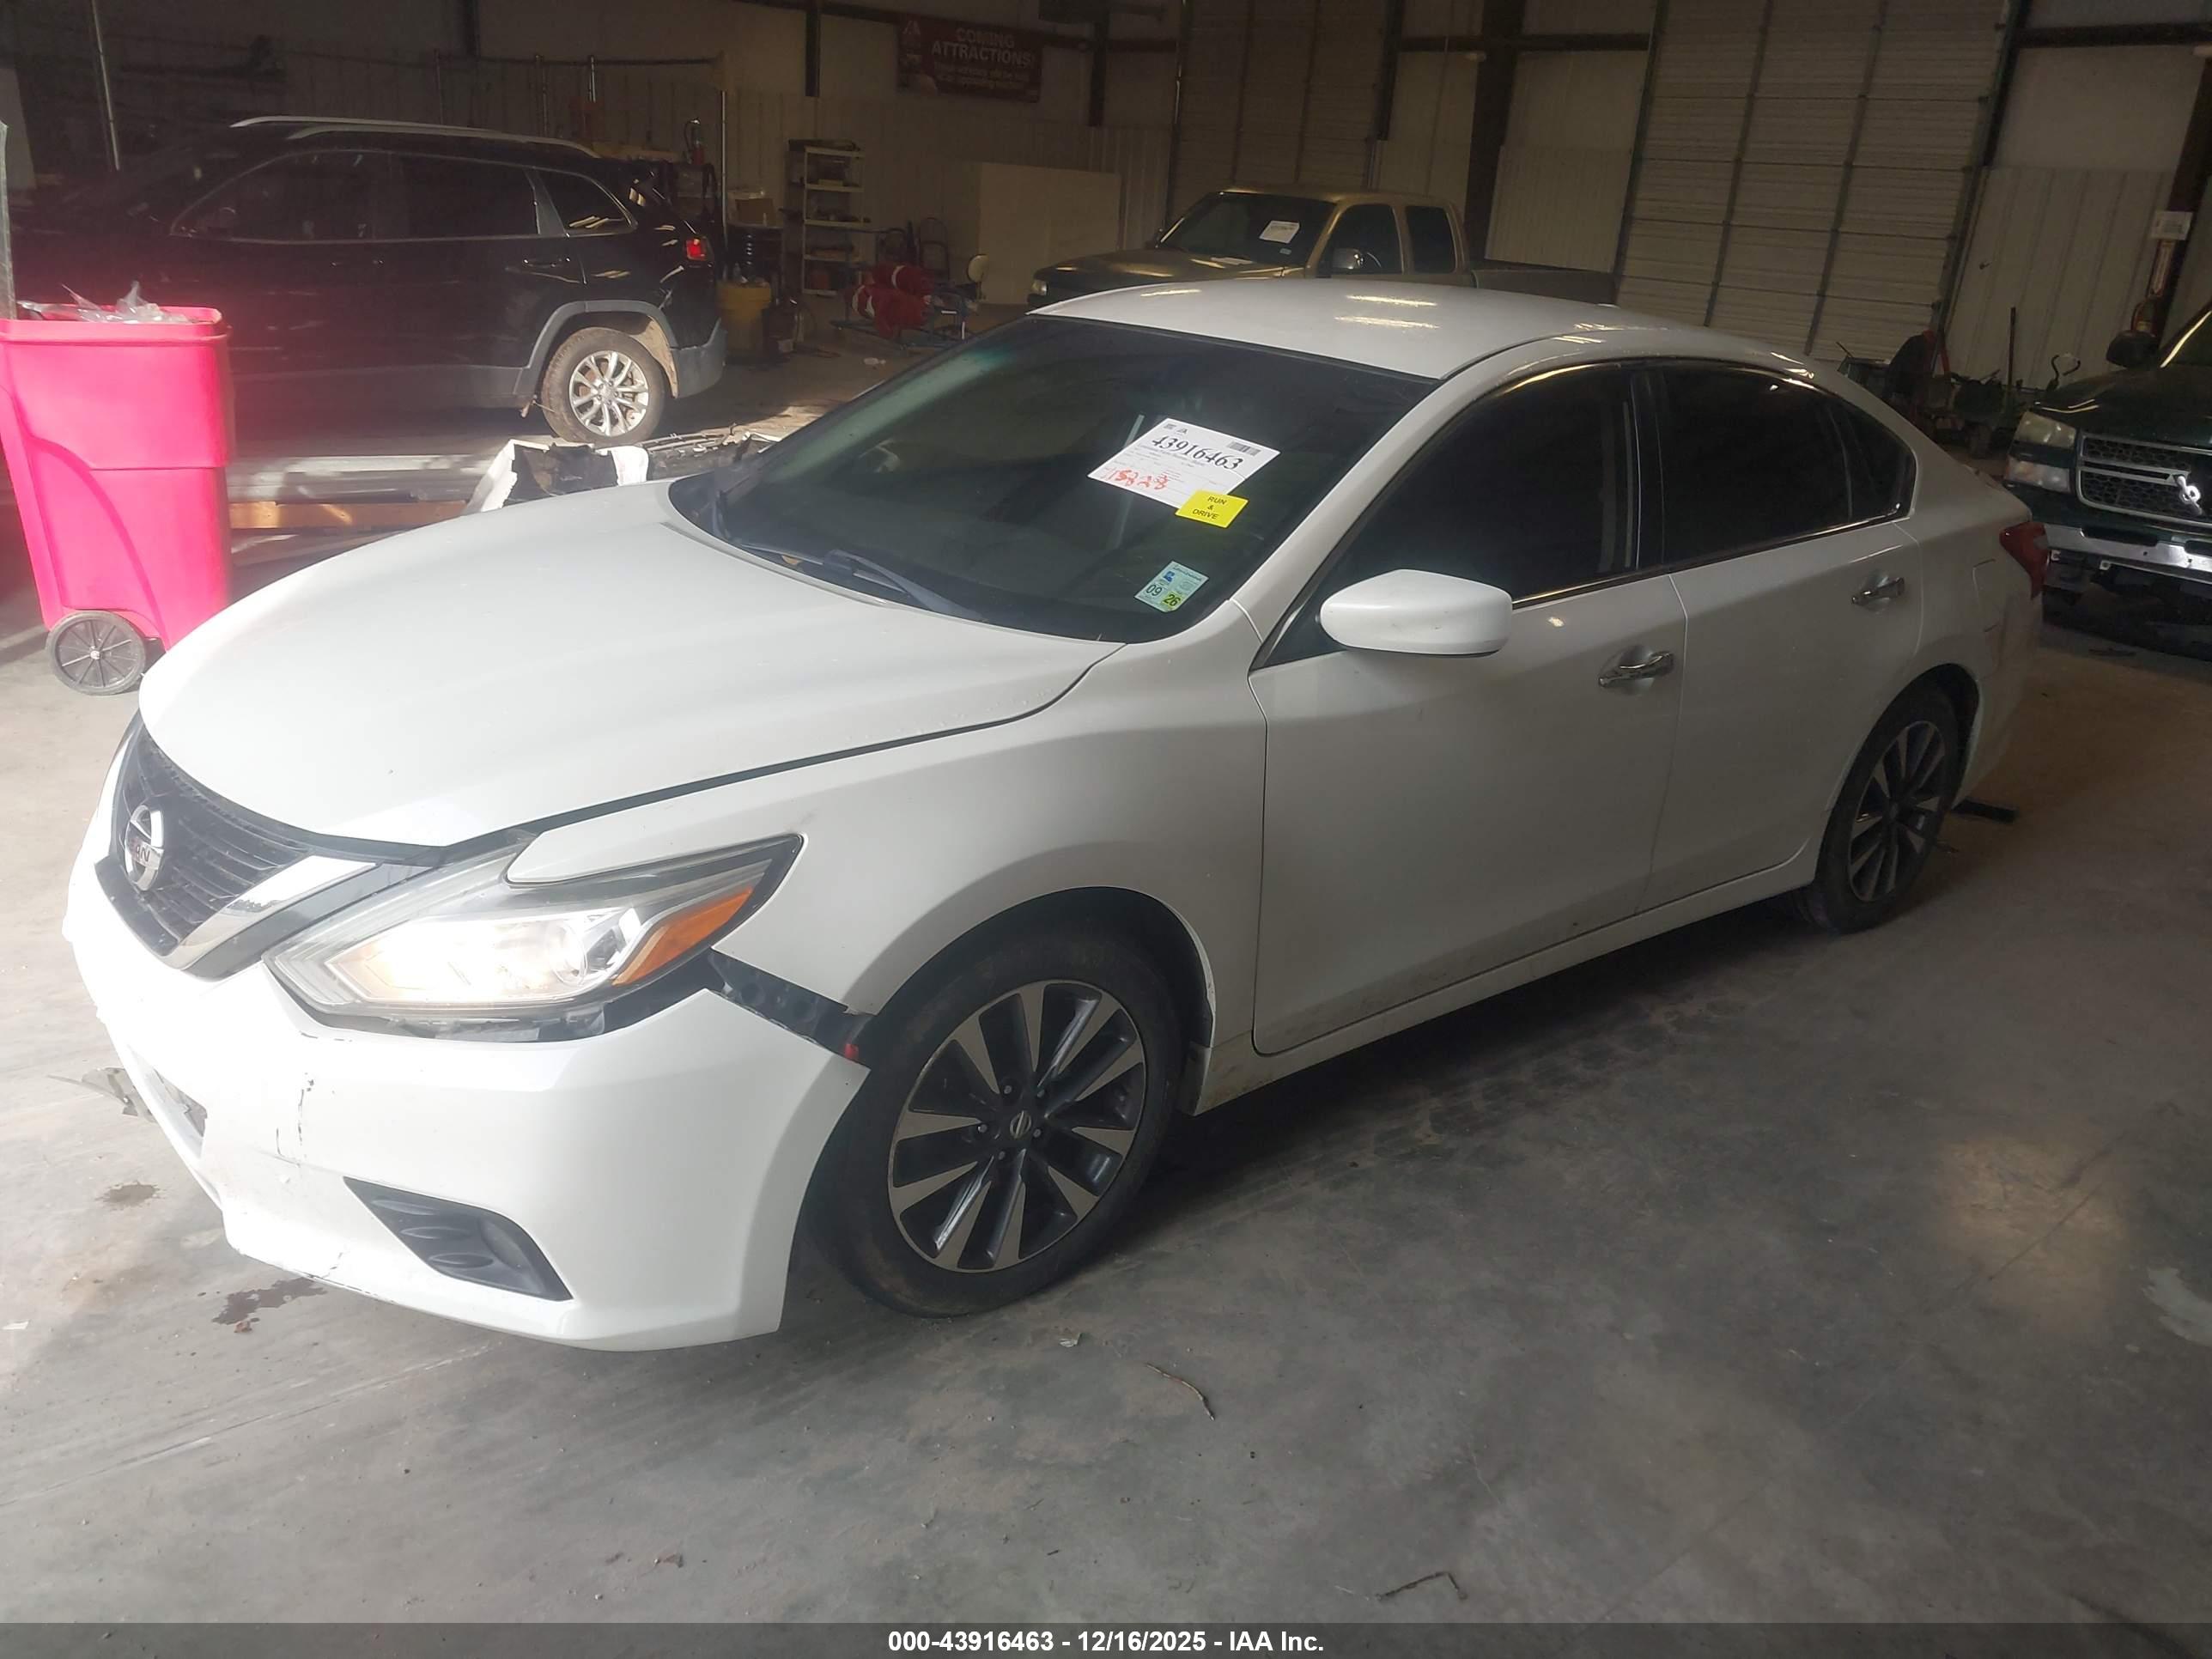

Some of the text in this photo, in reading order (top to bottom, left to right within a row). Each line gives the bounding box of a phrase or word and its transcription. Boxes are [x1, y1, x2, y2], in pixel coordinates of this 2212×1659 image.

[1152, 434, 1243, 471] 43916463
[1207, 495, 1228, 505] RUN
[1192, 508, 1219, 520] DRIVE
[1146, 584, 1162, 596] 09
[1164, 593, 1181, 606] 26
